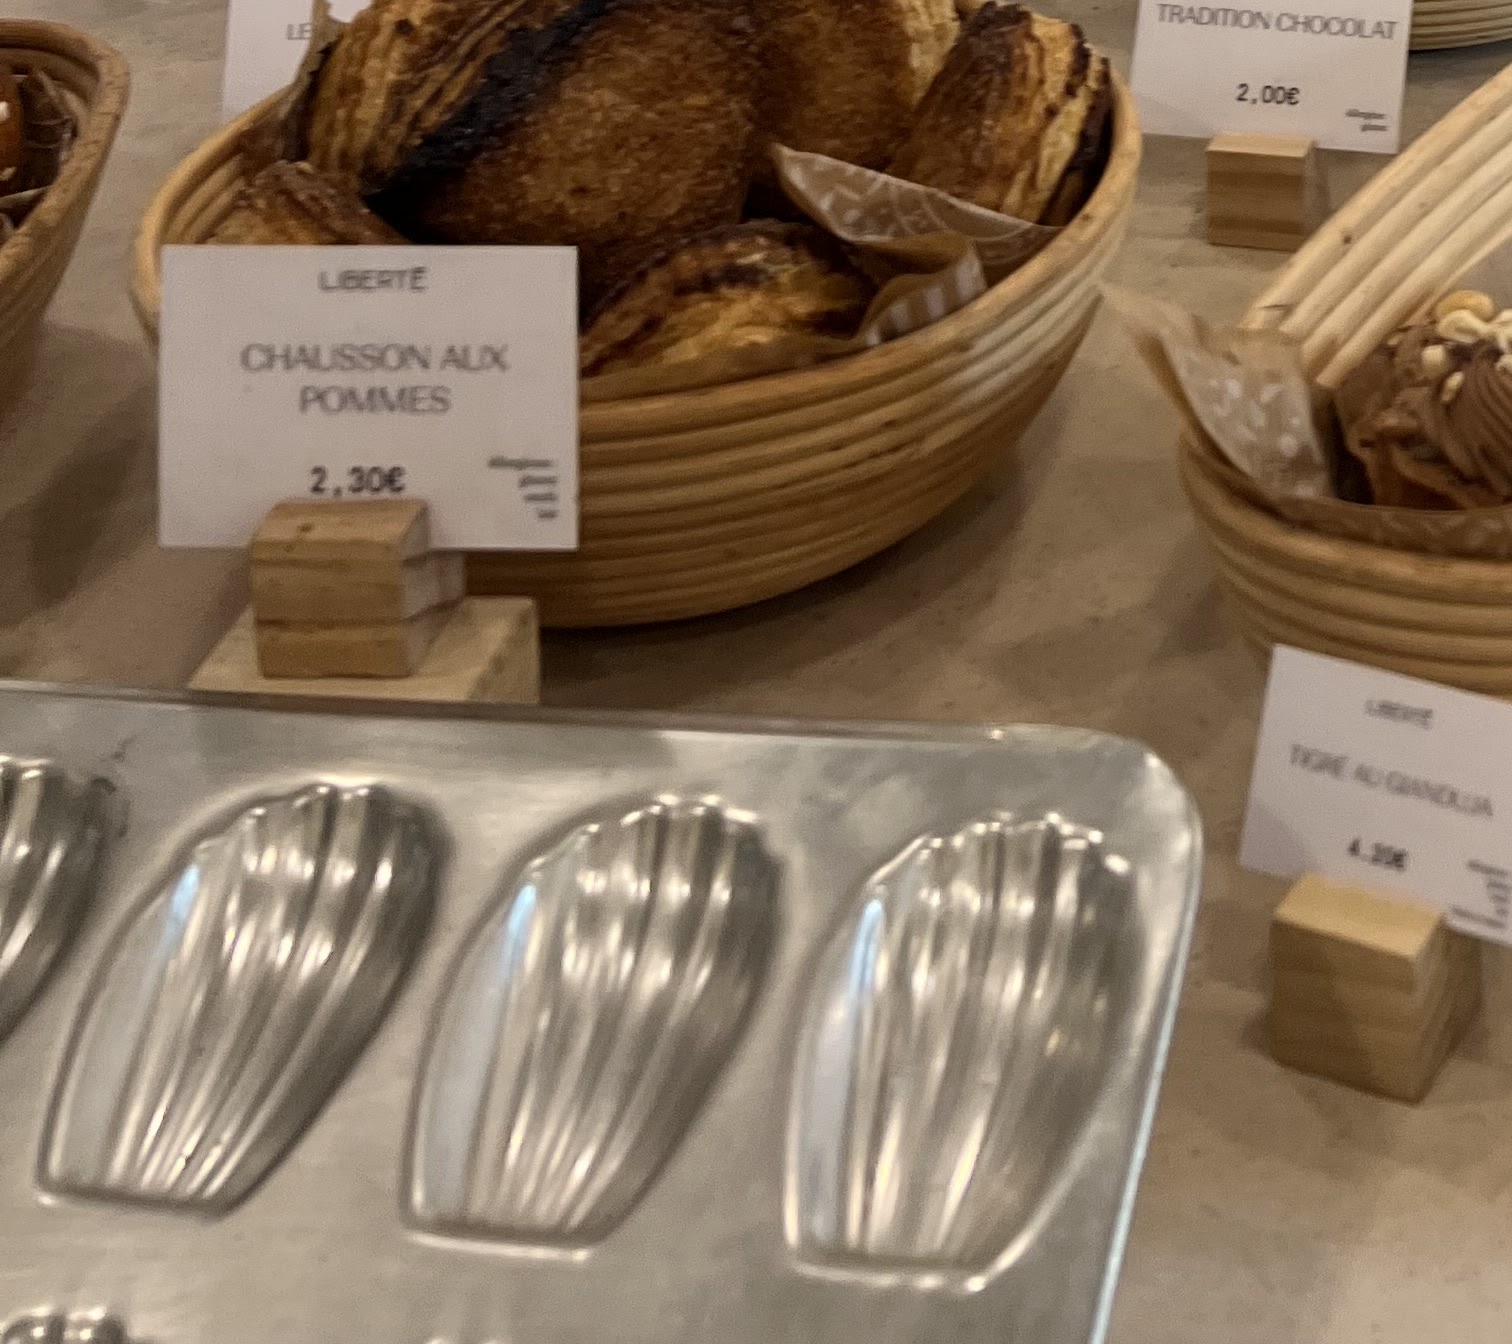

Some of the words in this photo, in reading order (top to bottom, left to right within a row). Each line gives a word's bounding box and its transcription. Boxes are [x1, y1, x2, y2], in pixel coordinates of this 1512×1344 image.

[1157, 3, 1271, 30] TRADITION
[1275, 13, 1399, 41] CHOCOLAT
[318, 266, 429, 293] LIBERTÉ
[240, 343, 431, 373] CHAUSSON
[440, 343, 510, 372] AUX
[300, 384, 452, 414] POMMES
